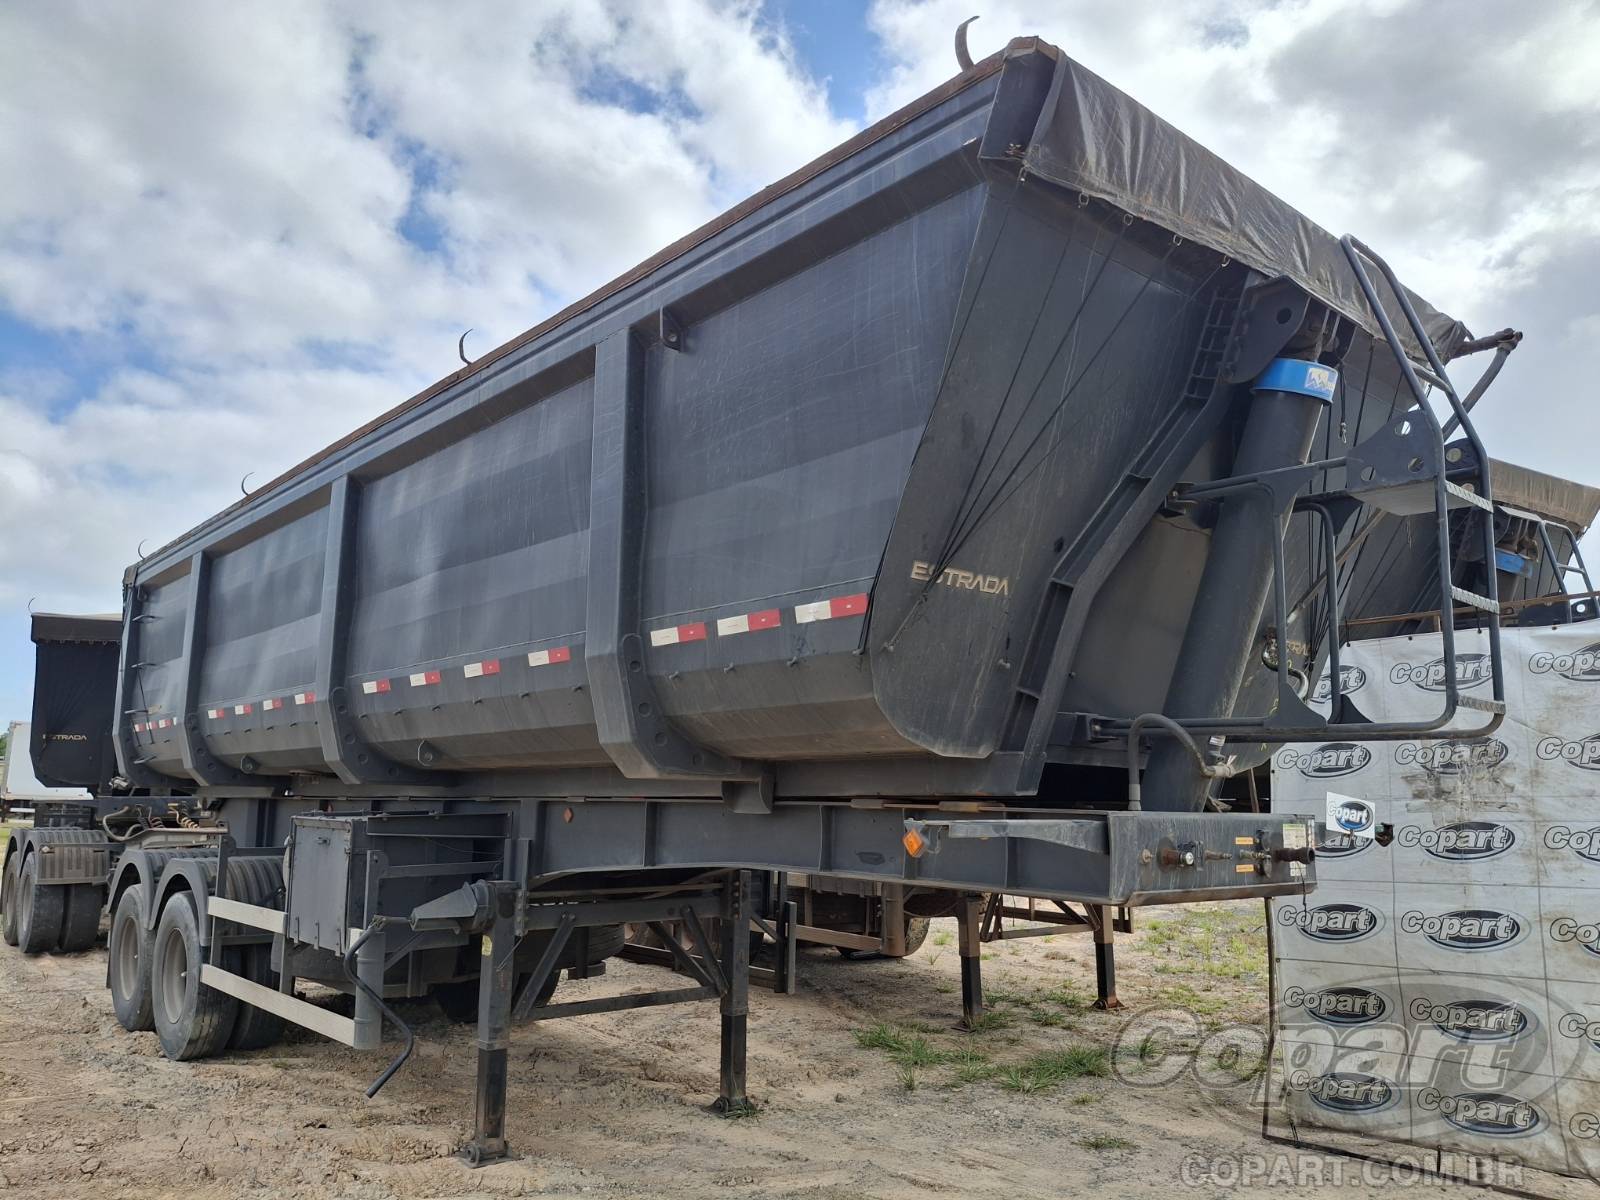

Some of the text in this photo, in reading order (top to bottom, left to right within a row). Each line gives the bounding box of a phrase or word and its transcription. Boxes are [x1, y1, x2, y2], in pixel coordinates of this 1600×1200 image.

[910, 560, 1008, 596] ETRADA
[1277, 748, 1365, 771] Copart
[1328, 801, 1368, 824] Copart
[1398, 825, 1509, 854] Copart
[1278, 904, 1371, 932] Copart
[1401, 910, 1513, 940] Copart
[1284, 986, 1382, 1016] Copart
[1410, 998, 1518, 1032] Copart
[1290, 1069, 1387, 1103] Copart
[1417, 1087, 1531, 1127] Copart
